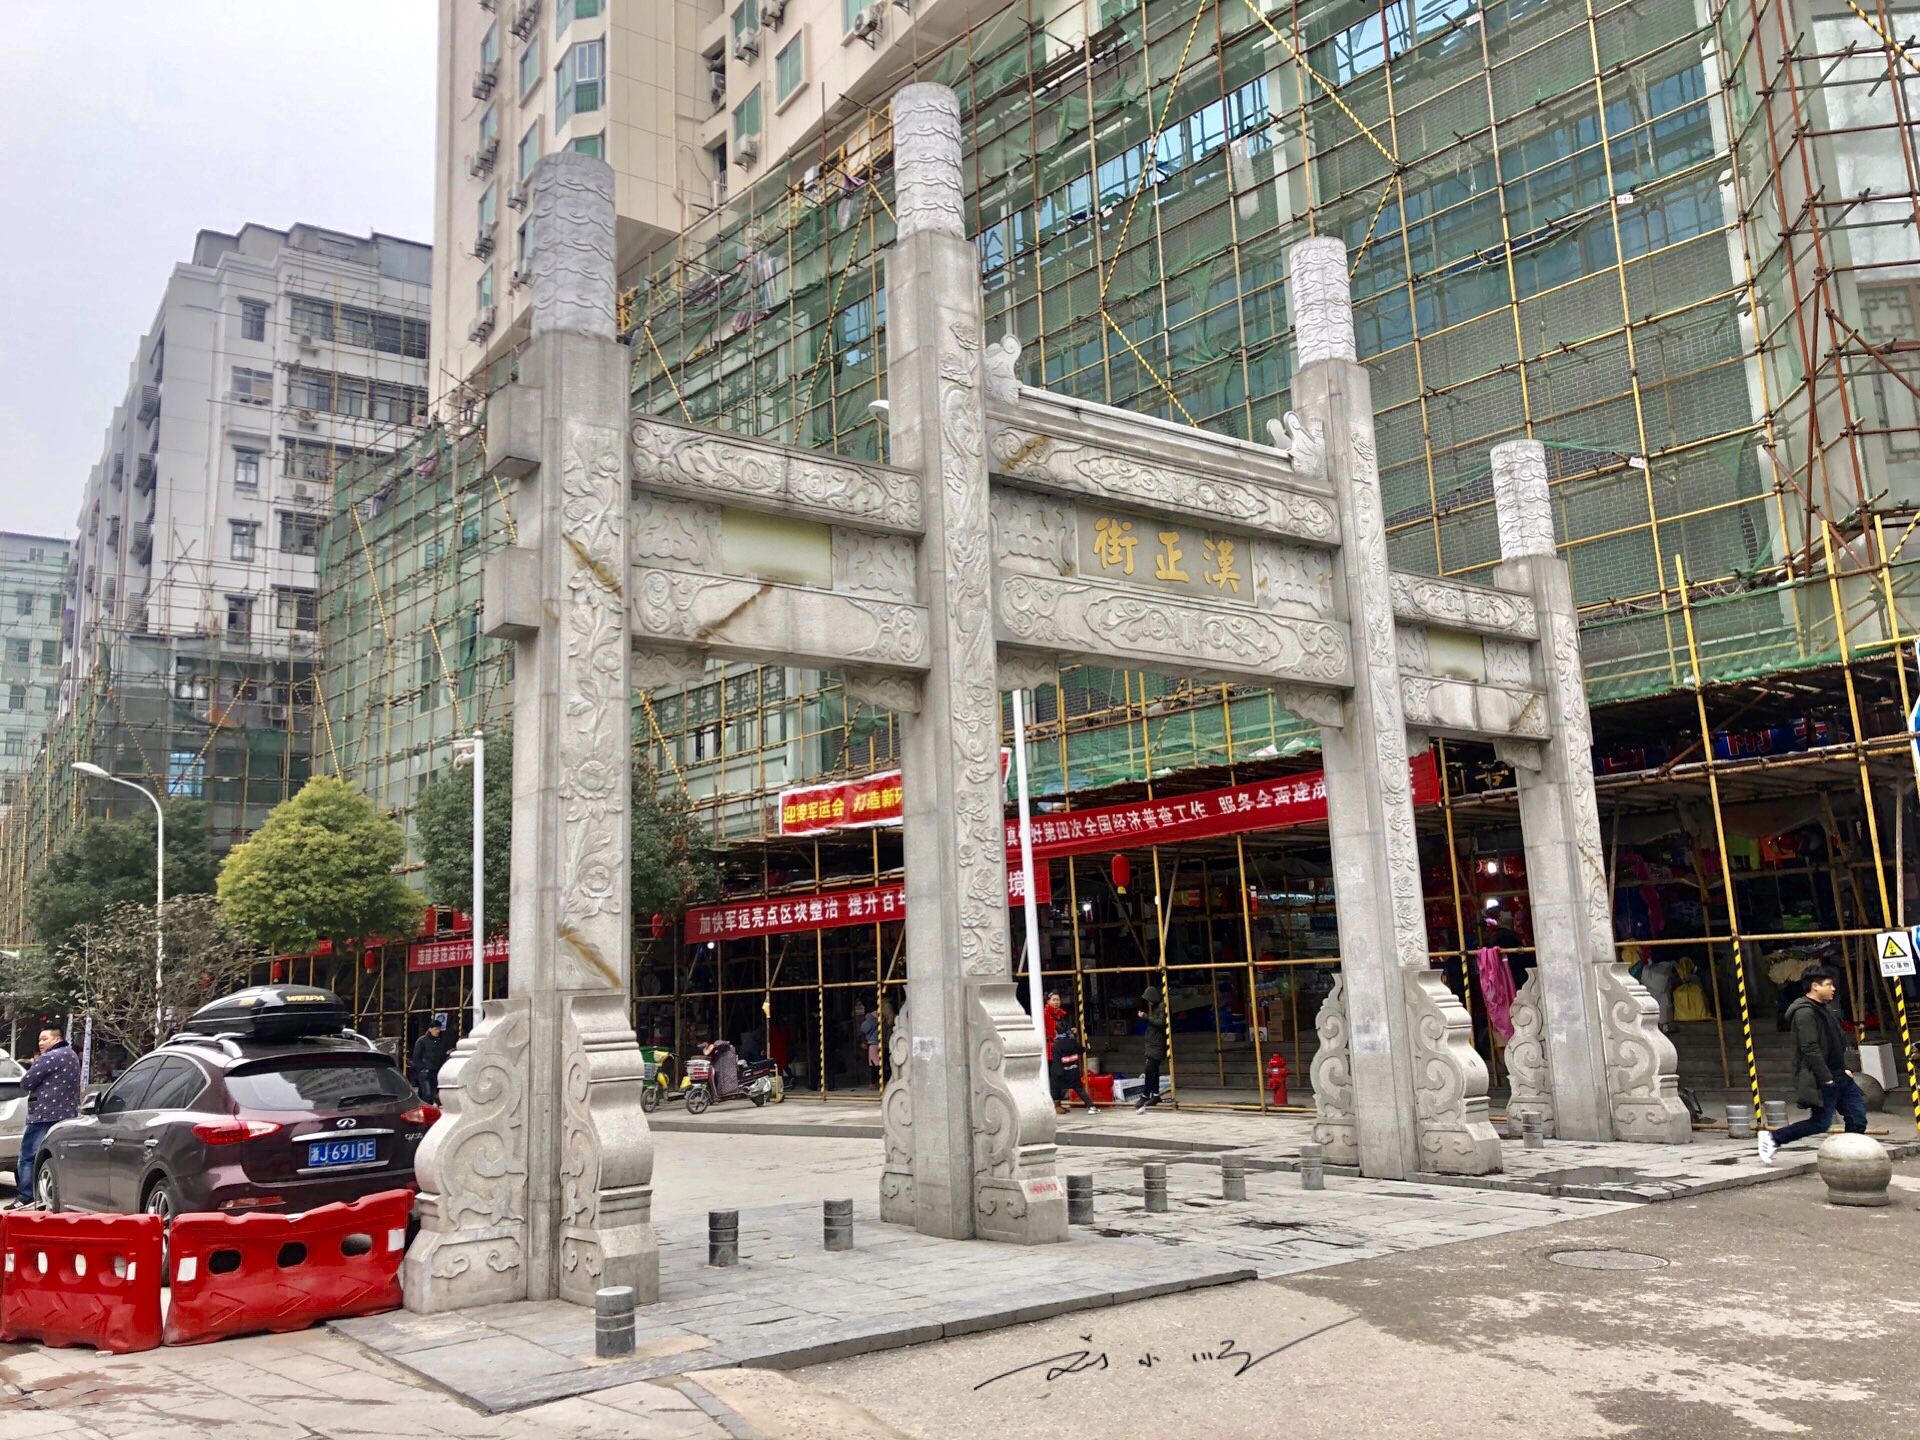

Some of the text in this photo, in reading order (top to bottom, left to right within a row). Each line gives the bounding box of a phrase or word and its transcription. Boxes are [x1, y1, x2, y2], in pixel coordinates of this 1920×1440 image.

[783, 797, 844, 824] 迎接军运会
[699, 896, 839, 935] 加快军运亮点区块整治
